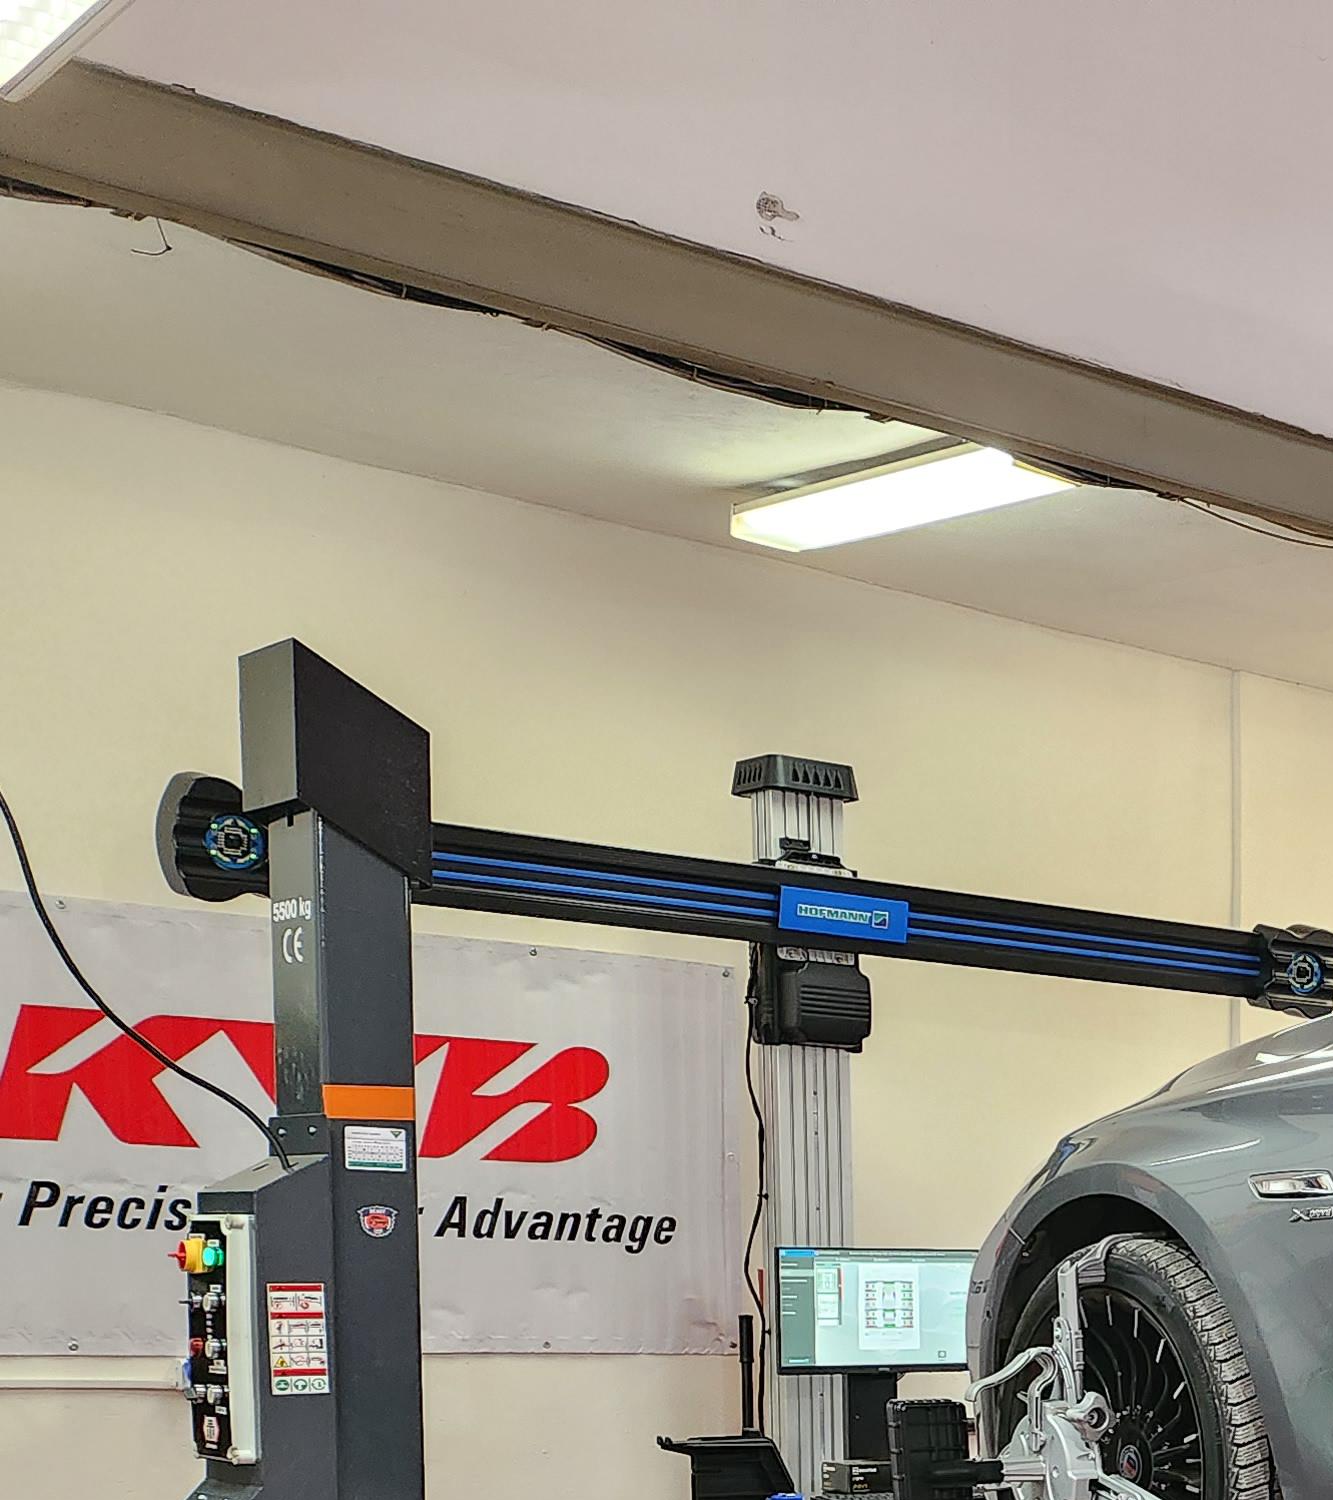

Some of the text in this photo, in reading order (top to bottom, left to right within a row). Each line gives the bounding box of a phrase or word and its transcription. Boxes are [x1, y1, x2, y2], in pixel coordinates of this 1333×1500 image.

[272, 896, 311, 922] 5500 kg
[798, 904, 870, 923] HOFMANN
[283, 926, 304, 963] CE
[18, 1180, 677, 1254] Precis Advantage
